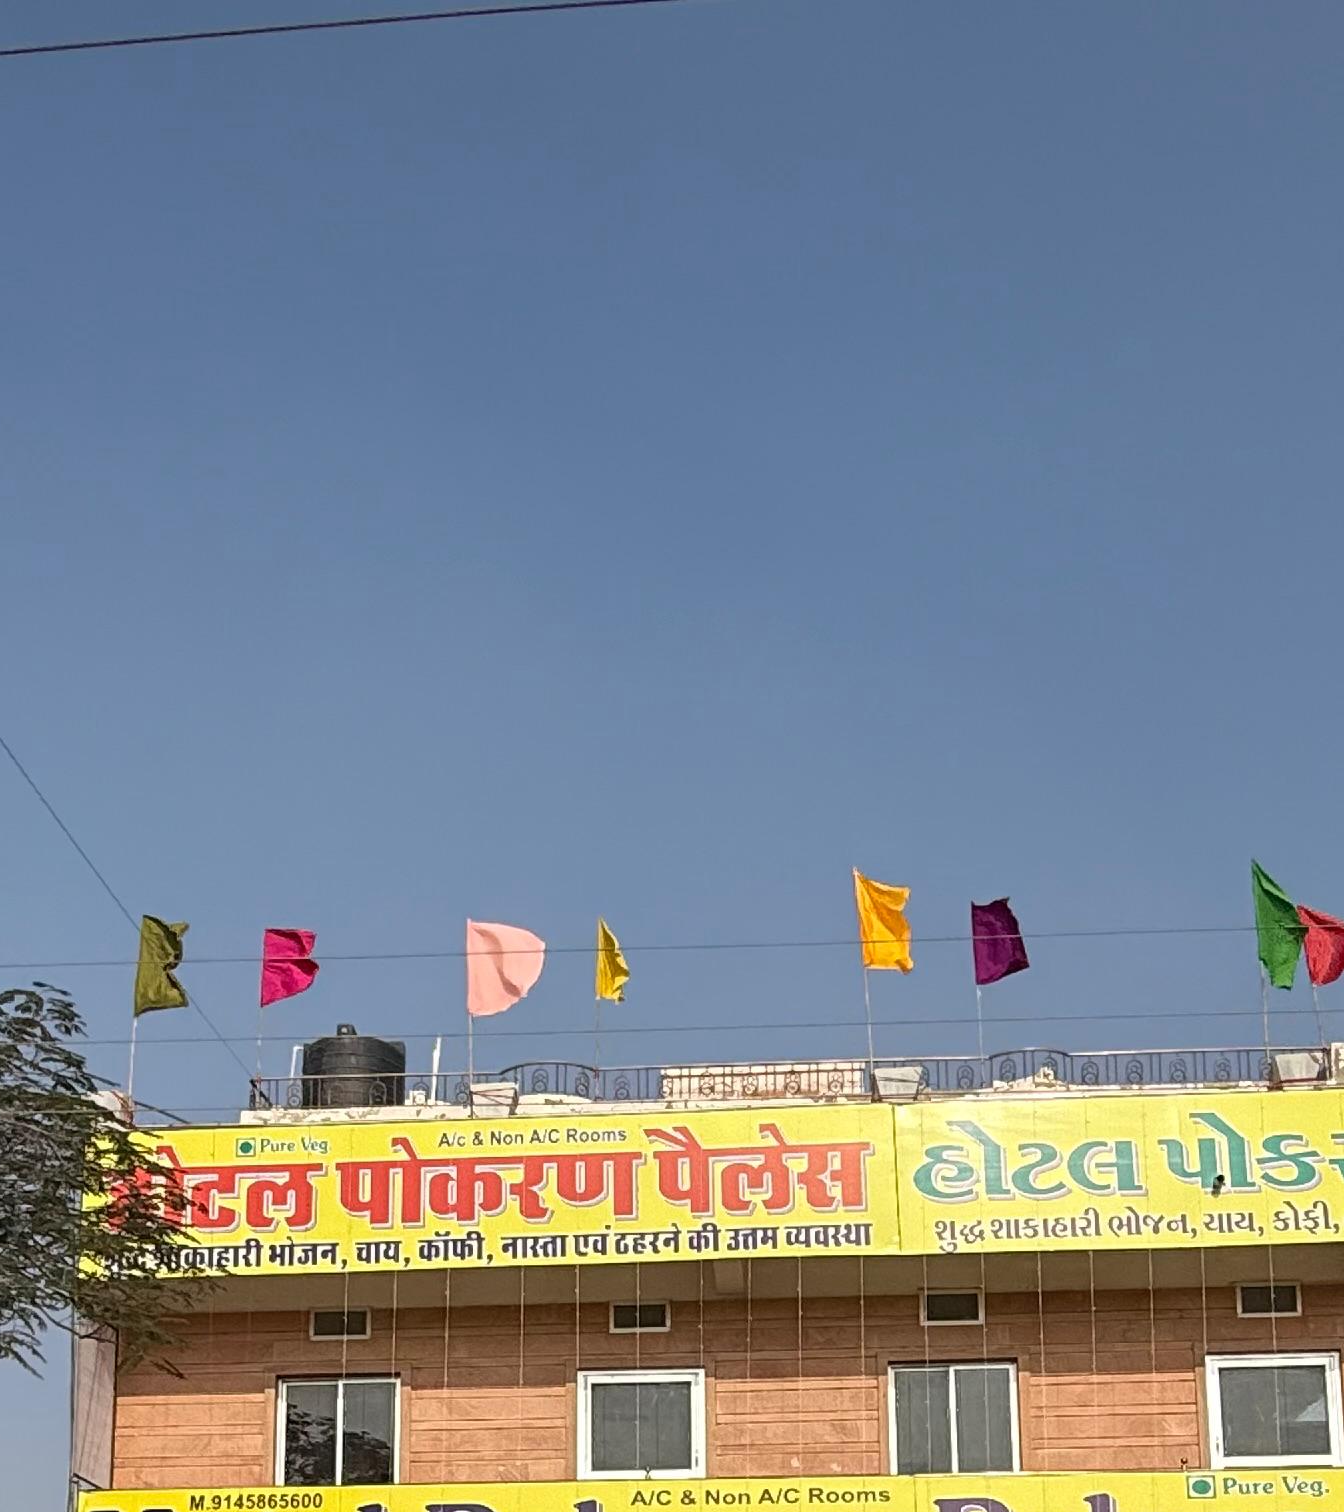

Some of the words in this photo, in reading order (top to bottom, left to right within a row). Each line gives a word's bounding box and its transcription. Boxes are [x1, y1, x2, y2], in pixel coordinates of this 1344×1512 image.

[260, 1138, 296, 1153] Pure
[472, 1131, 484, 1146] &
[490, 1130, 524, 1145] Non
[529, 1129, 560, 1144] A/C
[567, 1128, 627, 1143] Rooms
[913, 1120, 1146, 1202] હોટલ
[336, 1137, 644, 1227] पोकरण
[644, 1123, 873, 1216] पैलेस
[356, 1241, 410, 1268] चाय,
[614, 1223, 682, 1255] ठहरने
[687, 1222, 721, 1253] की
[785, 1223, 873, 1248] व्यवस्था
[630, 1490, 672, 1506] A/C
[680, 1490, 696, 1505] &
[705, 1489, 751, 1505] Non
[758, 1488, 800, 1504] A/C
[808, 1487, 890, 1504] Rooms
[1222, 1476, 1274, 1495] Pure
[1281, 1476, 1330, 1497] Veg.
[189, 1493, 323, 1511] M.9145865600
